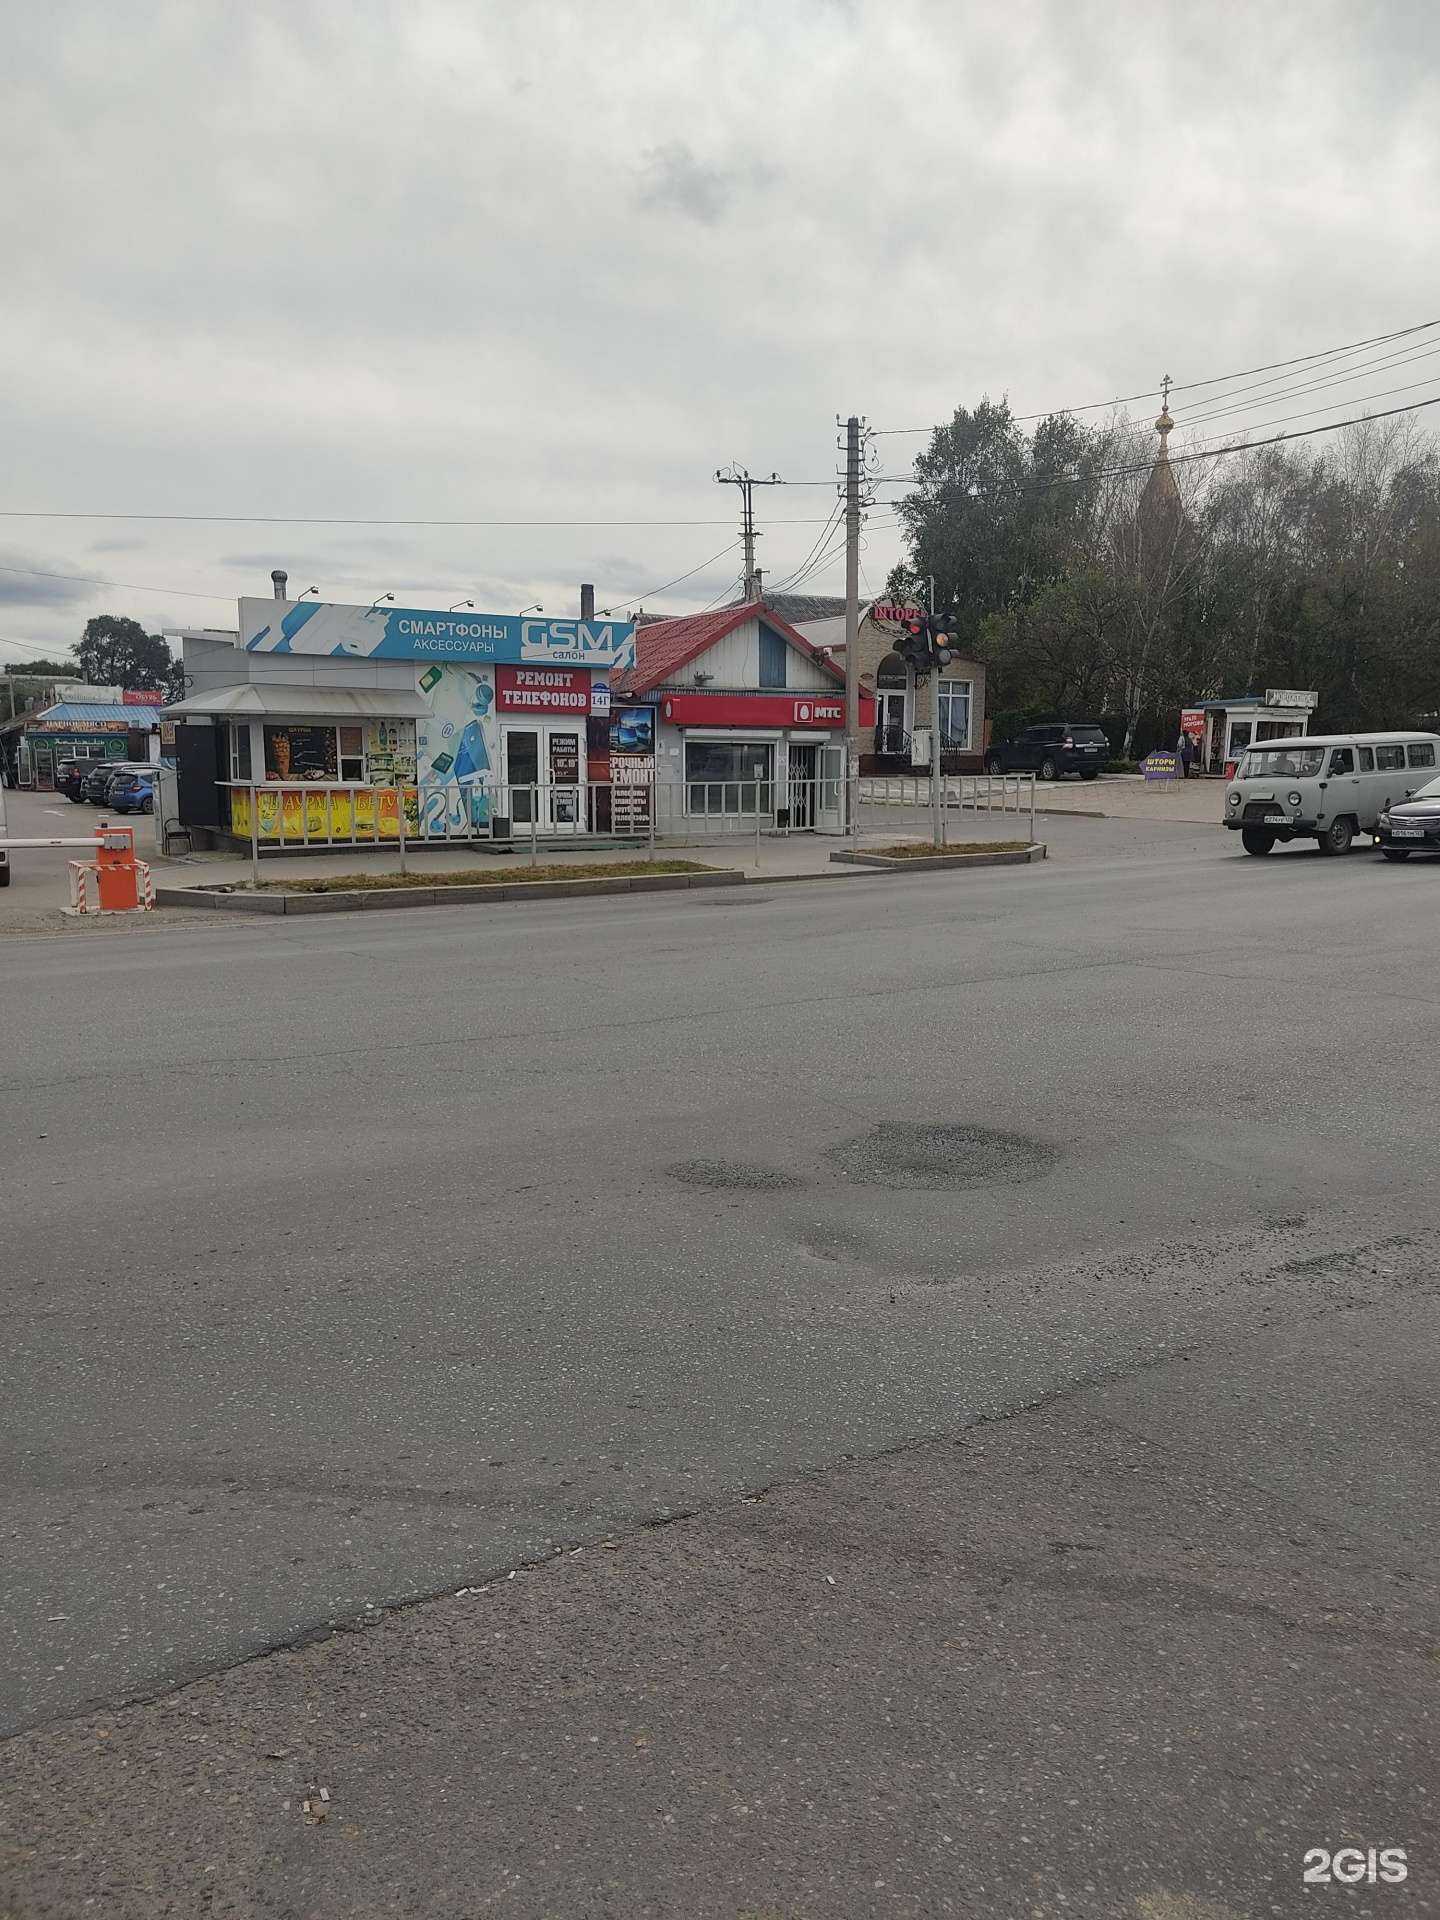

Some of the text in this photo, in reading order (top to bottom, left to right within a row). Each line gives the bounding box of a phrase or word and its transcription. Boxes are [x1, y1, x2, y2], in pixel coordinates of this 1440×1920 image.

[398, 619, 508, 640] СМАРТФОНЫ
[520, 620, 613, 651] GSM
[413, 638, 495, 653] АКСЕССУАРЫ
[552, 650, 586, 661] салон
[516, 671, 574, 687] РЕМОНТ
[502, 690, 587, 708] ТЕЛЕФОНОВ
[813, 706, 842, 719] МТС
[552, 738, 576, 746] РЕЖИМ
[1146, 758, 1176, 766] ШТОРЫ
